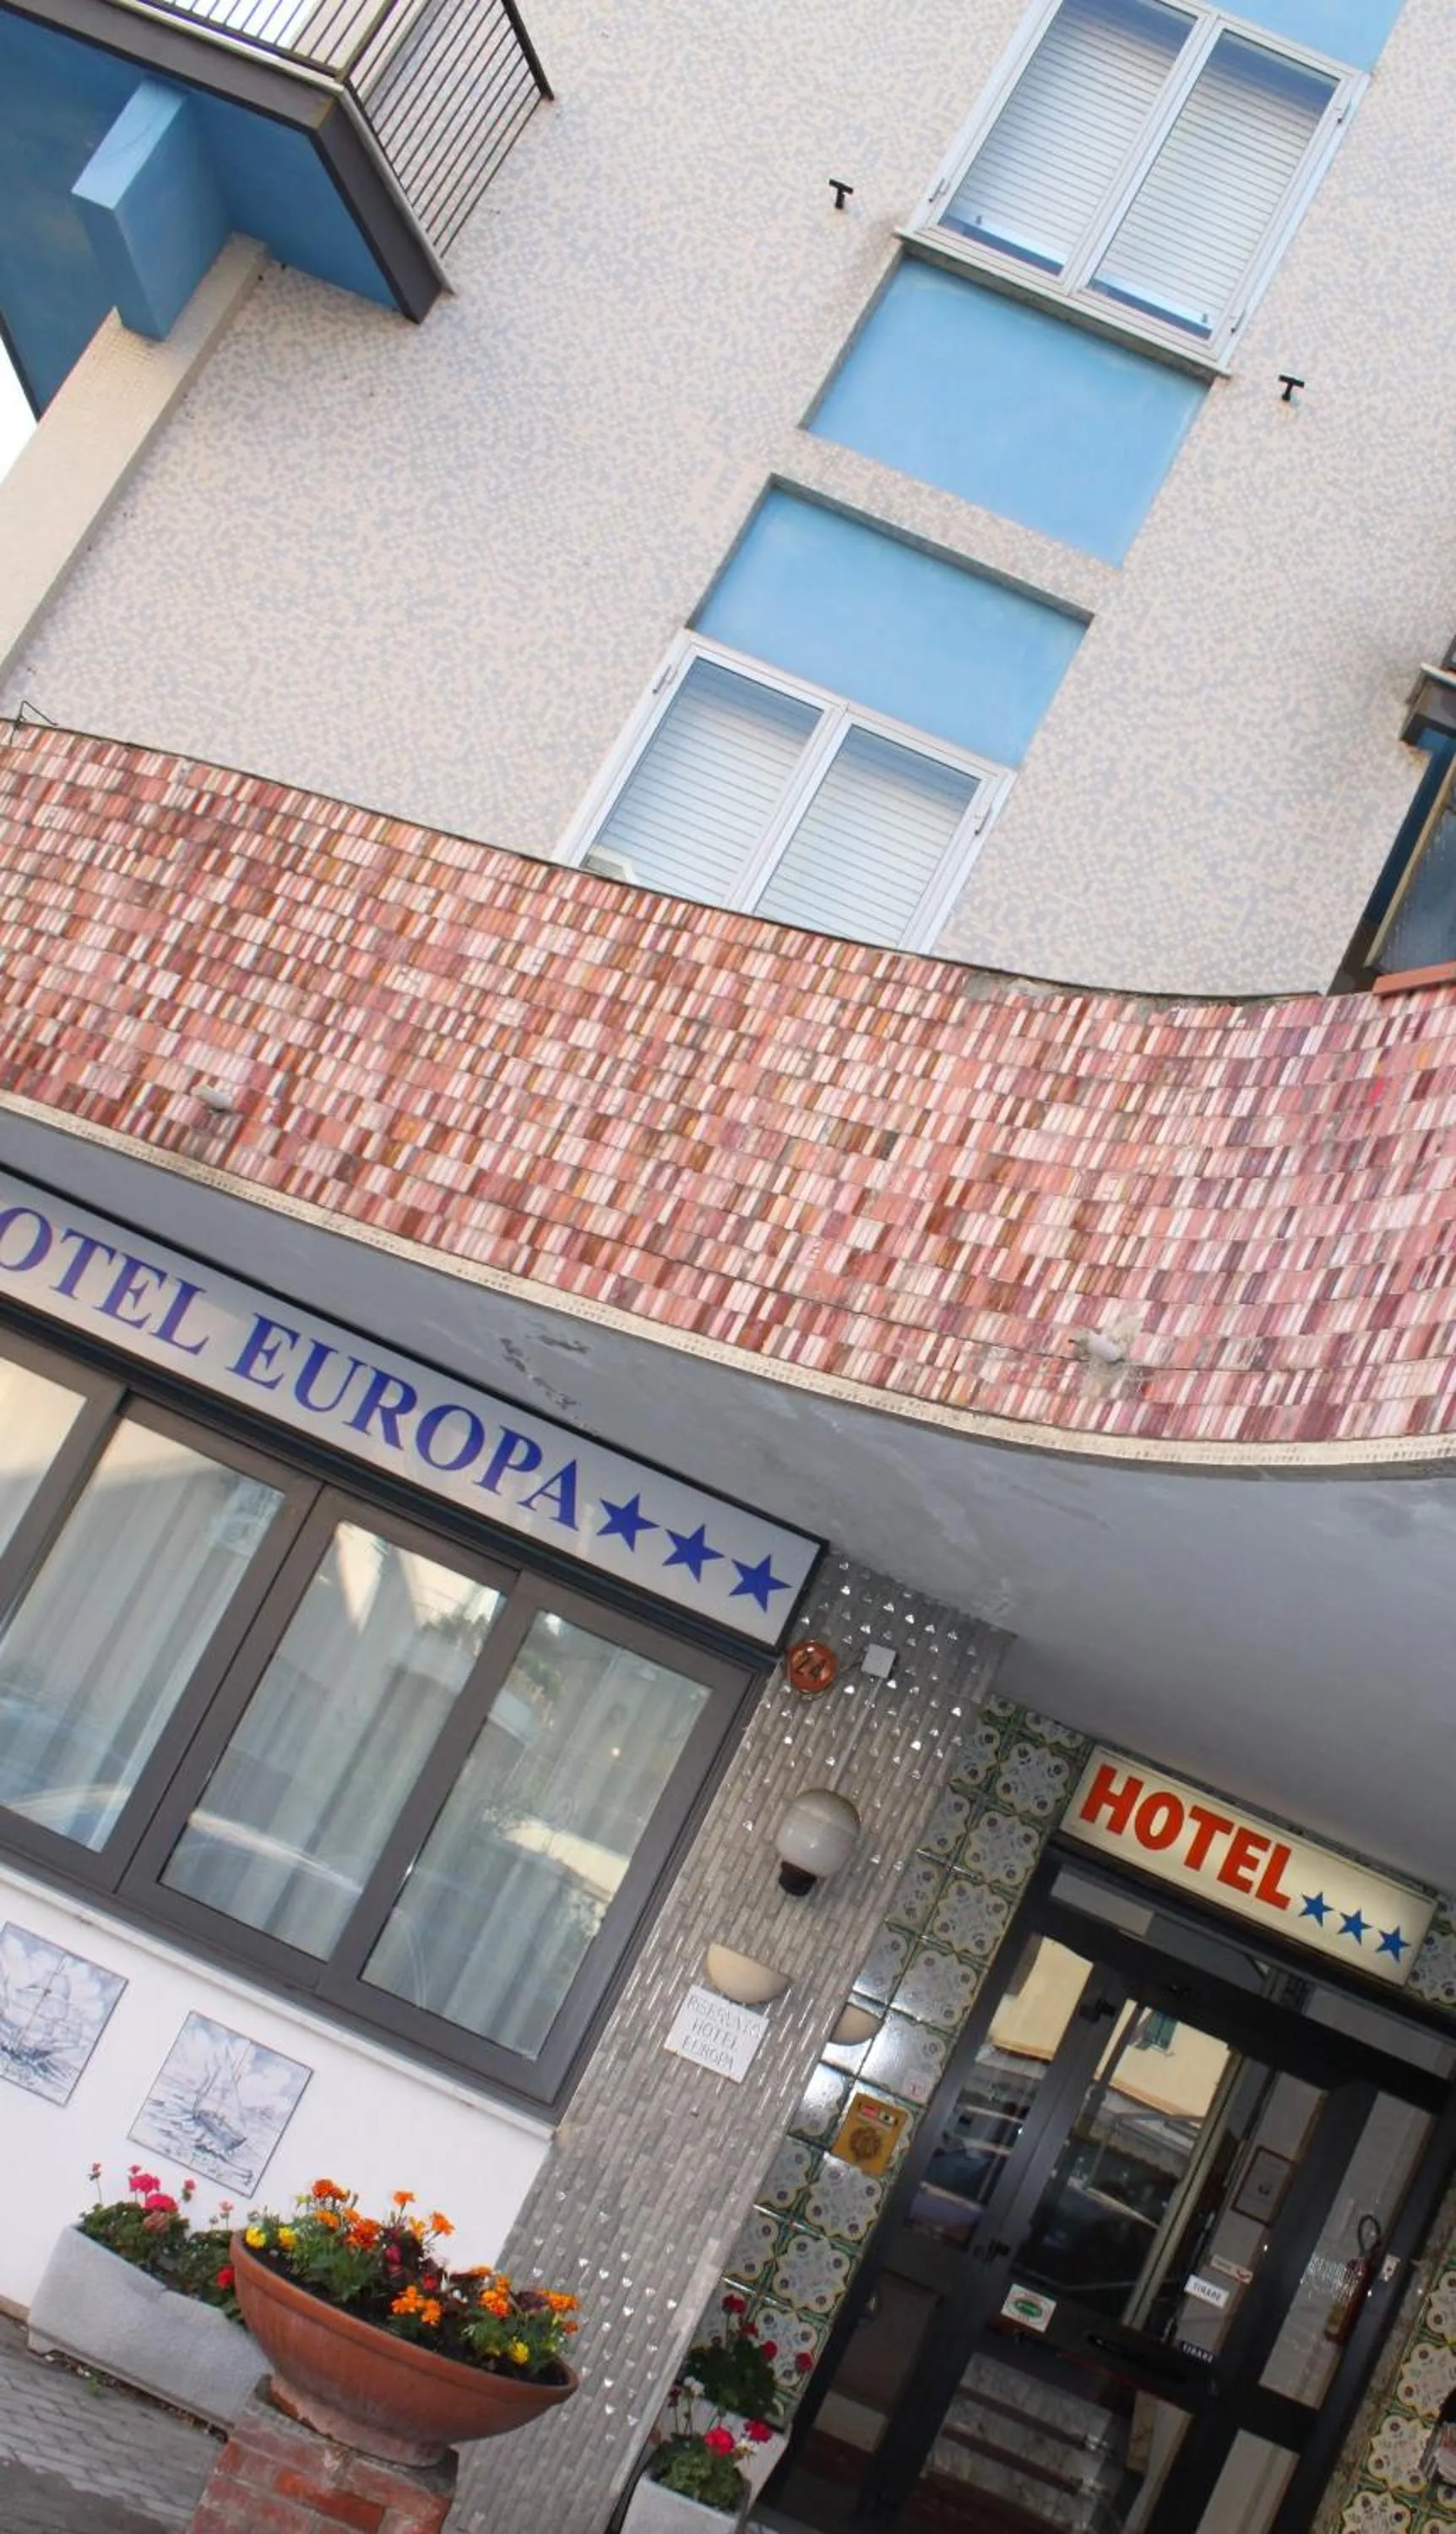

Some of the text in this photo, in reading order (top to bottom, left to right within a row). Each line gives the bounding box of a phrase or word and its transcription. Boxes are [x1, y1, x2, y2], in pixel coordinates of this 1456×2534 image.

[0, 1206, 579, 1531] OTEL EUROPA
[1079, 1763, 1292, 1911] HOTEL
